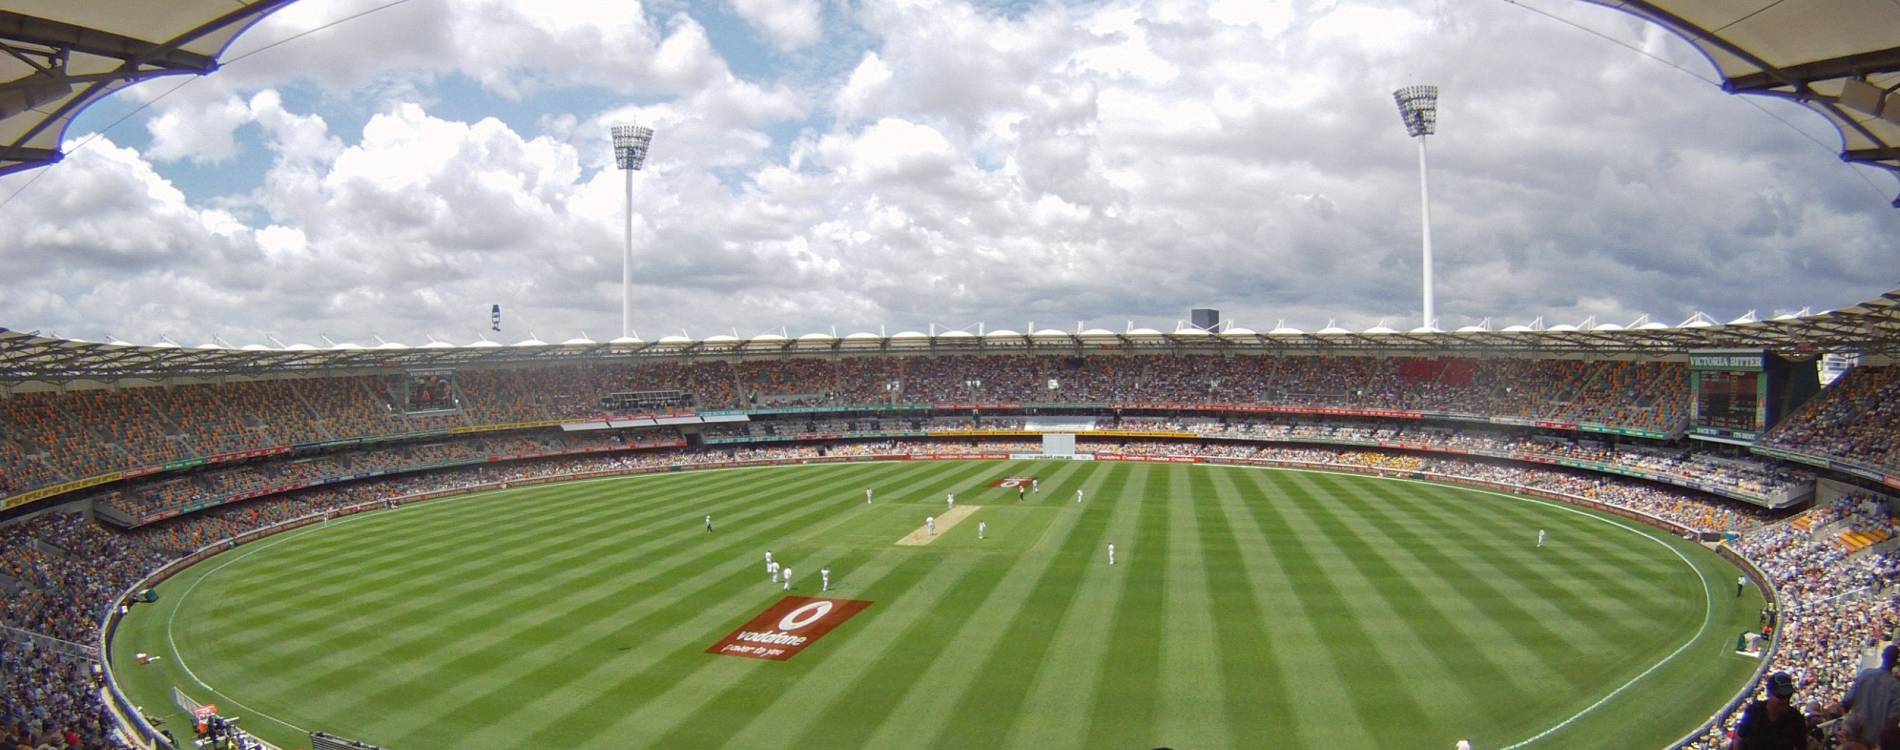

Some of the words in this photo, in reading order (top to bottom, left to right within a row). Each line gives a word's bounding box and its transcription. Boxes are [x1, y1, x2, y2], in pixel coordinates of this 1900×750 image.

[1689, 356, 1728, 367] VICTORIA
[1730, 356, 1762, 367] BITTER
[736, 630, 807, 646] vodafone
[720, 644, 755, 653] power
[753, 646, 767, 654] to
[760, 648, 785, 657] you
